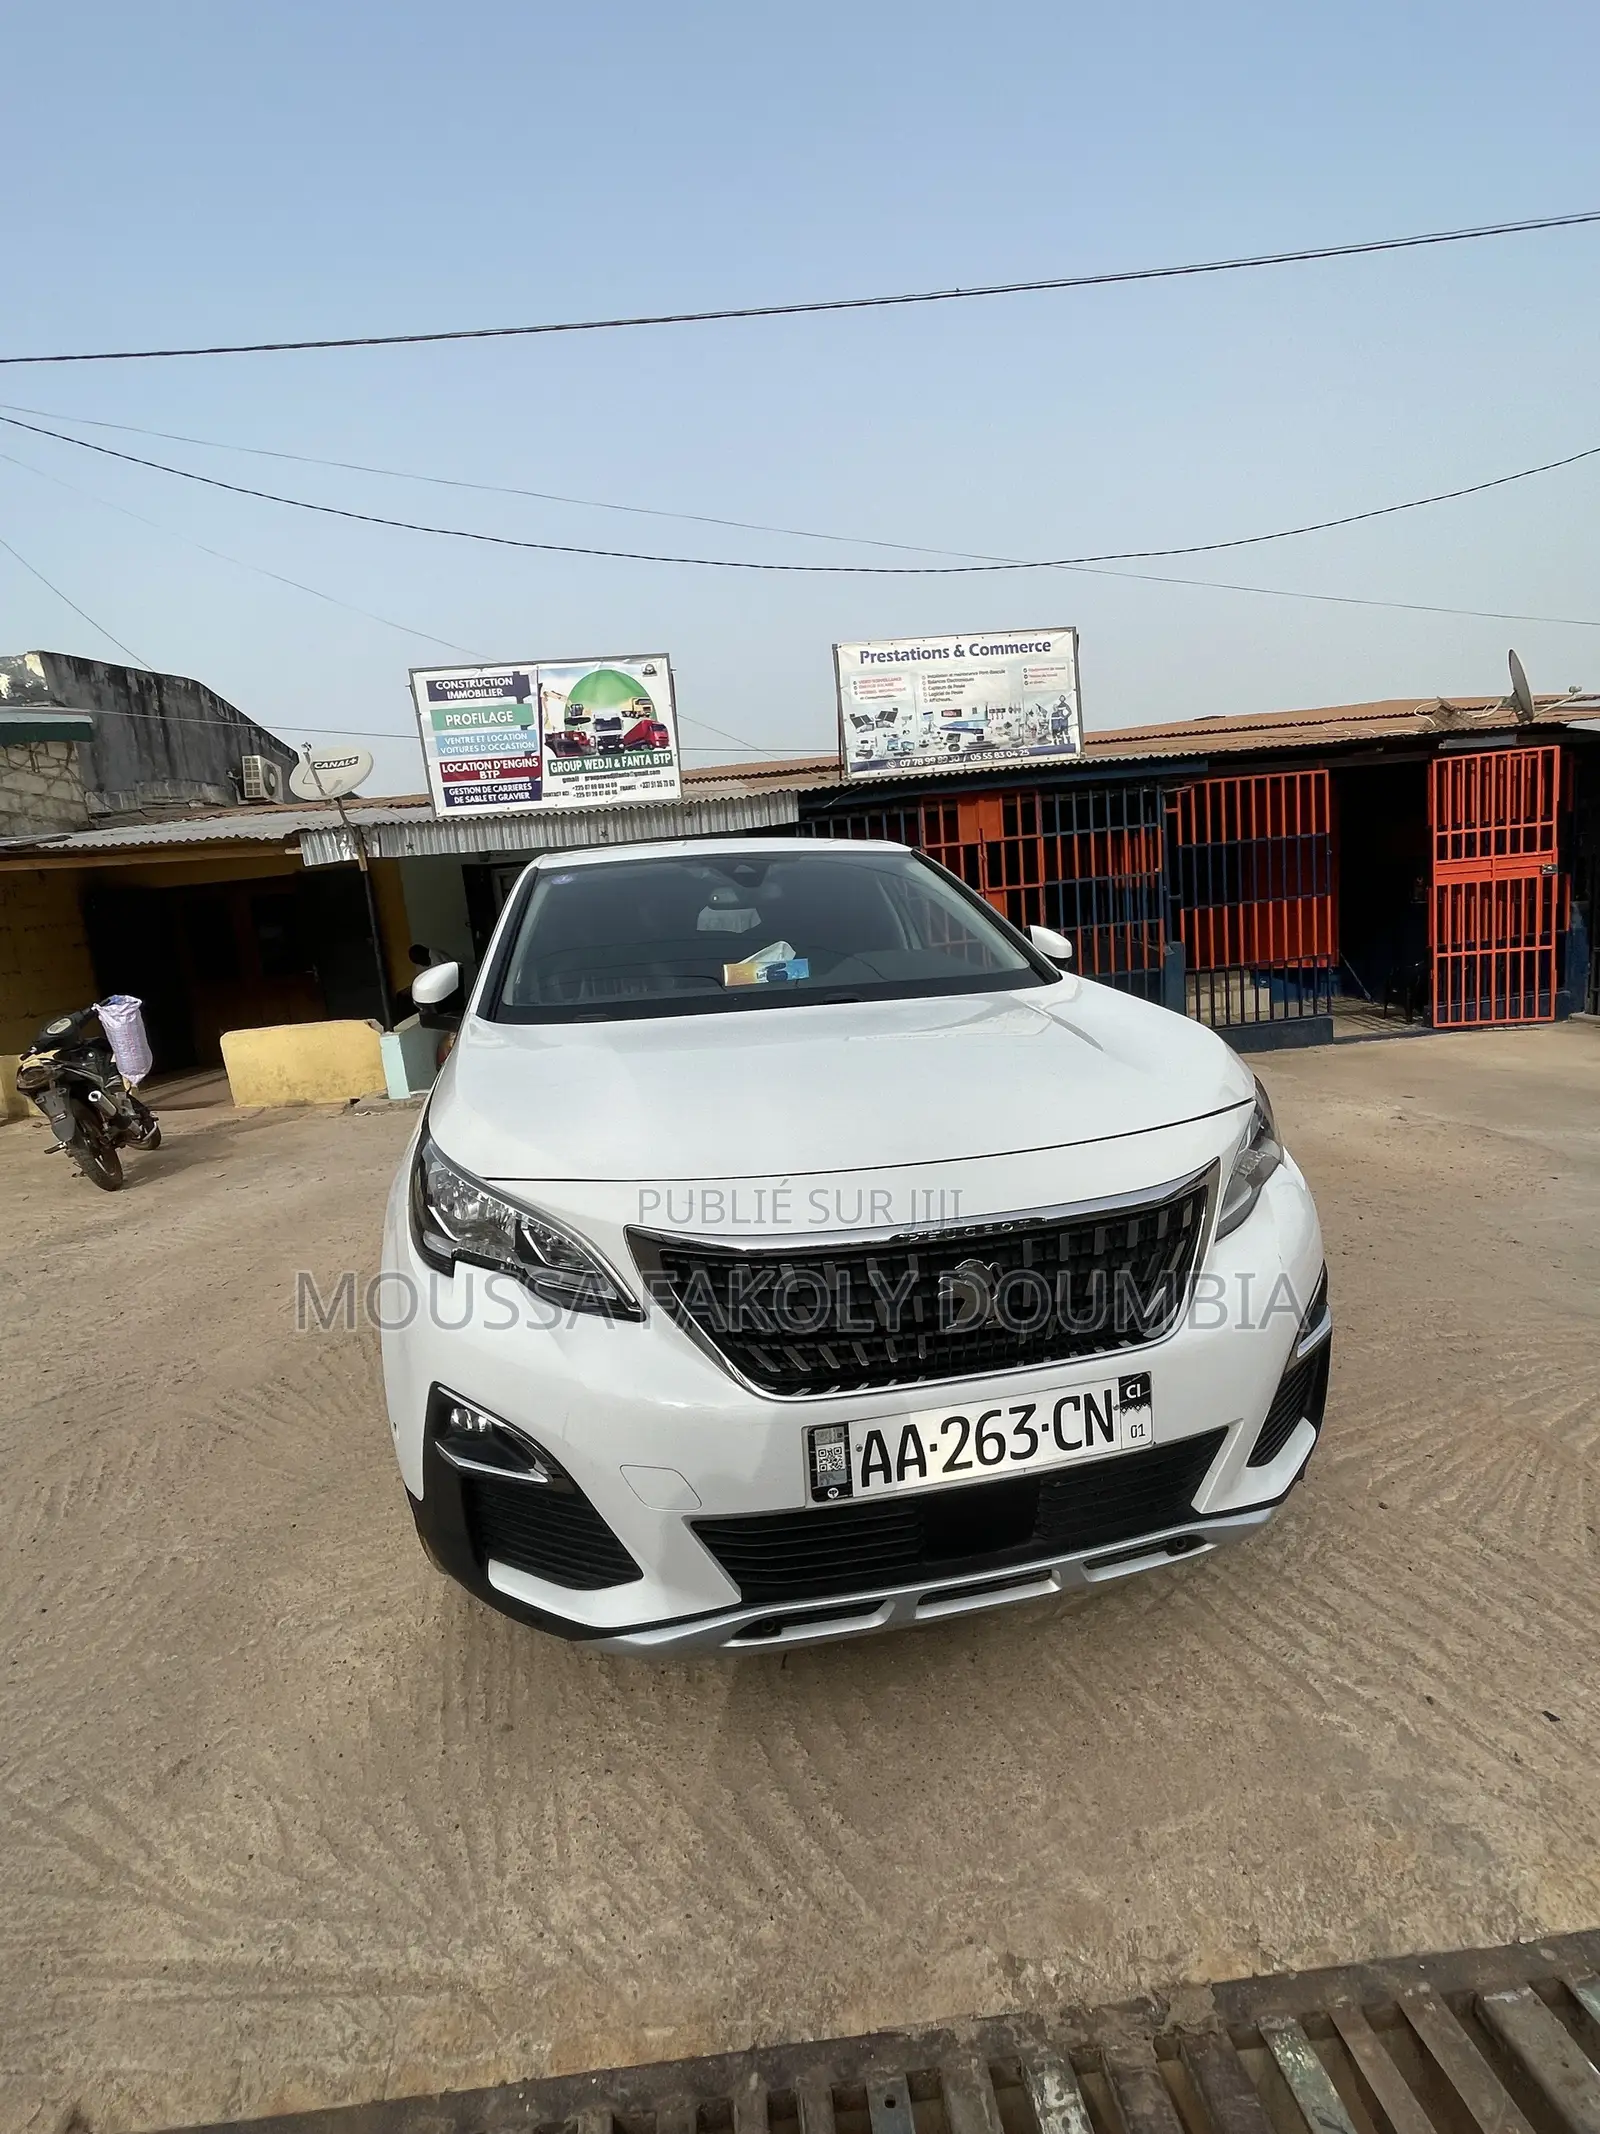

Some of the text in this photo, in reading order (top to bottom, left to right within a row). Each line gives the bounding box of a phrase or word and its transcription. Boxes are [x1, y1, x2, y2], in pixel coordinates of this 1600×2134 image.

[859, 640, 1051, 664] Prestations & Commerce
[435, 677, 514, 690] CONSTRUCTION
[446, 688, 504, 699] IMMOBILIER
[445, 710, 514, 727] PROFILAGE
[476, 735, 486, 743] ET
[486, 733, 528, 743] LOCATION
[440, 744, 479, 754] VOITURES
[313, 758, 358, 769] CANAL+
[441, 757, 539, 773] LOCATION D'ENGINS
[550, 754, 672, 773] GROUP WEDJI & FANTA BTP
[900, 759, 911, 767] 07
[911, 758, 923, 766] 78
[924, 756, 936, 764] 99
[970, 753, 981, 761] 05
[982, 752, 993, 760] 55
[479, 770, 500, 779] BTP
[448, 783, 533, 796] GESTION DE CARRIERES
[454, 792, 531, 804] DE SABLE ET GRAVIER
[1125, 1383, 1142, 1400] CI
[1129, 1424, 1146, 1439] 01
